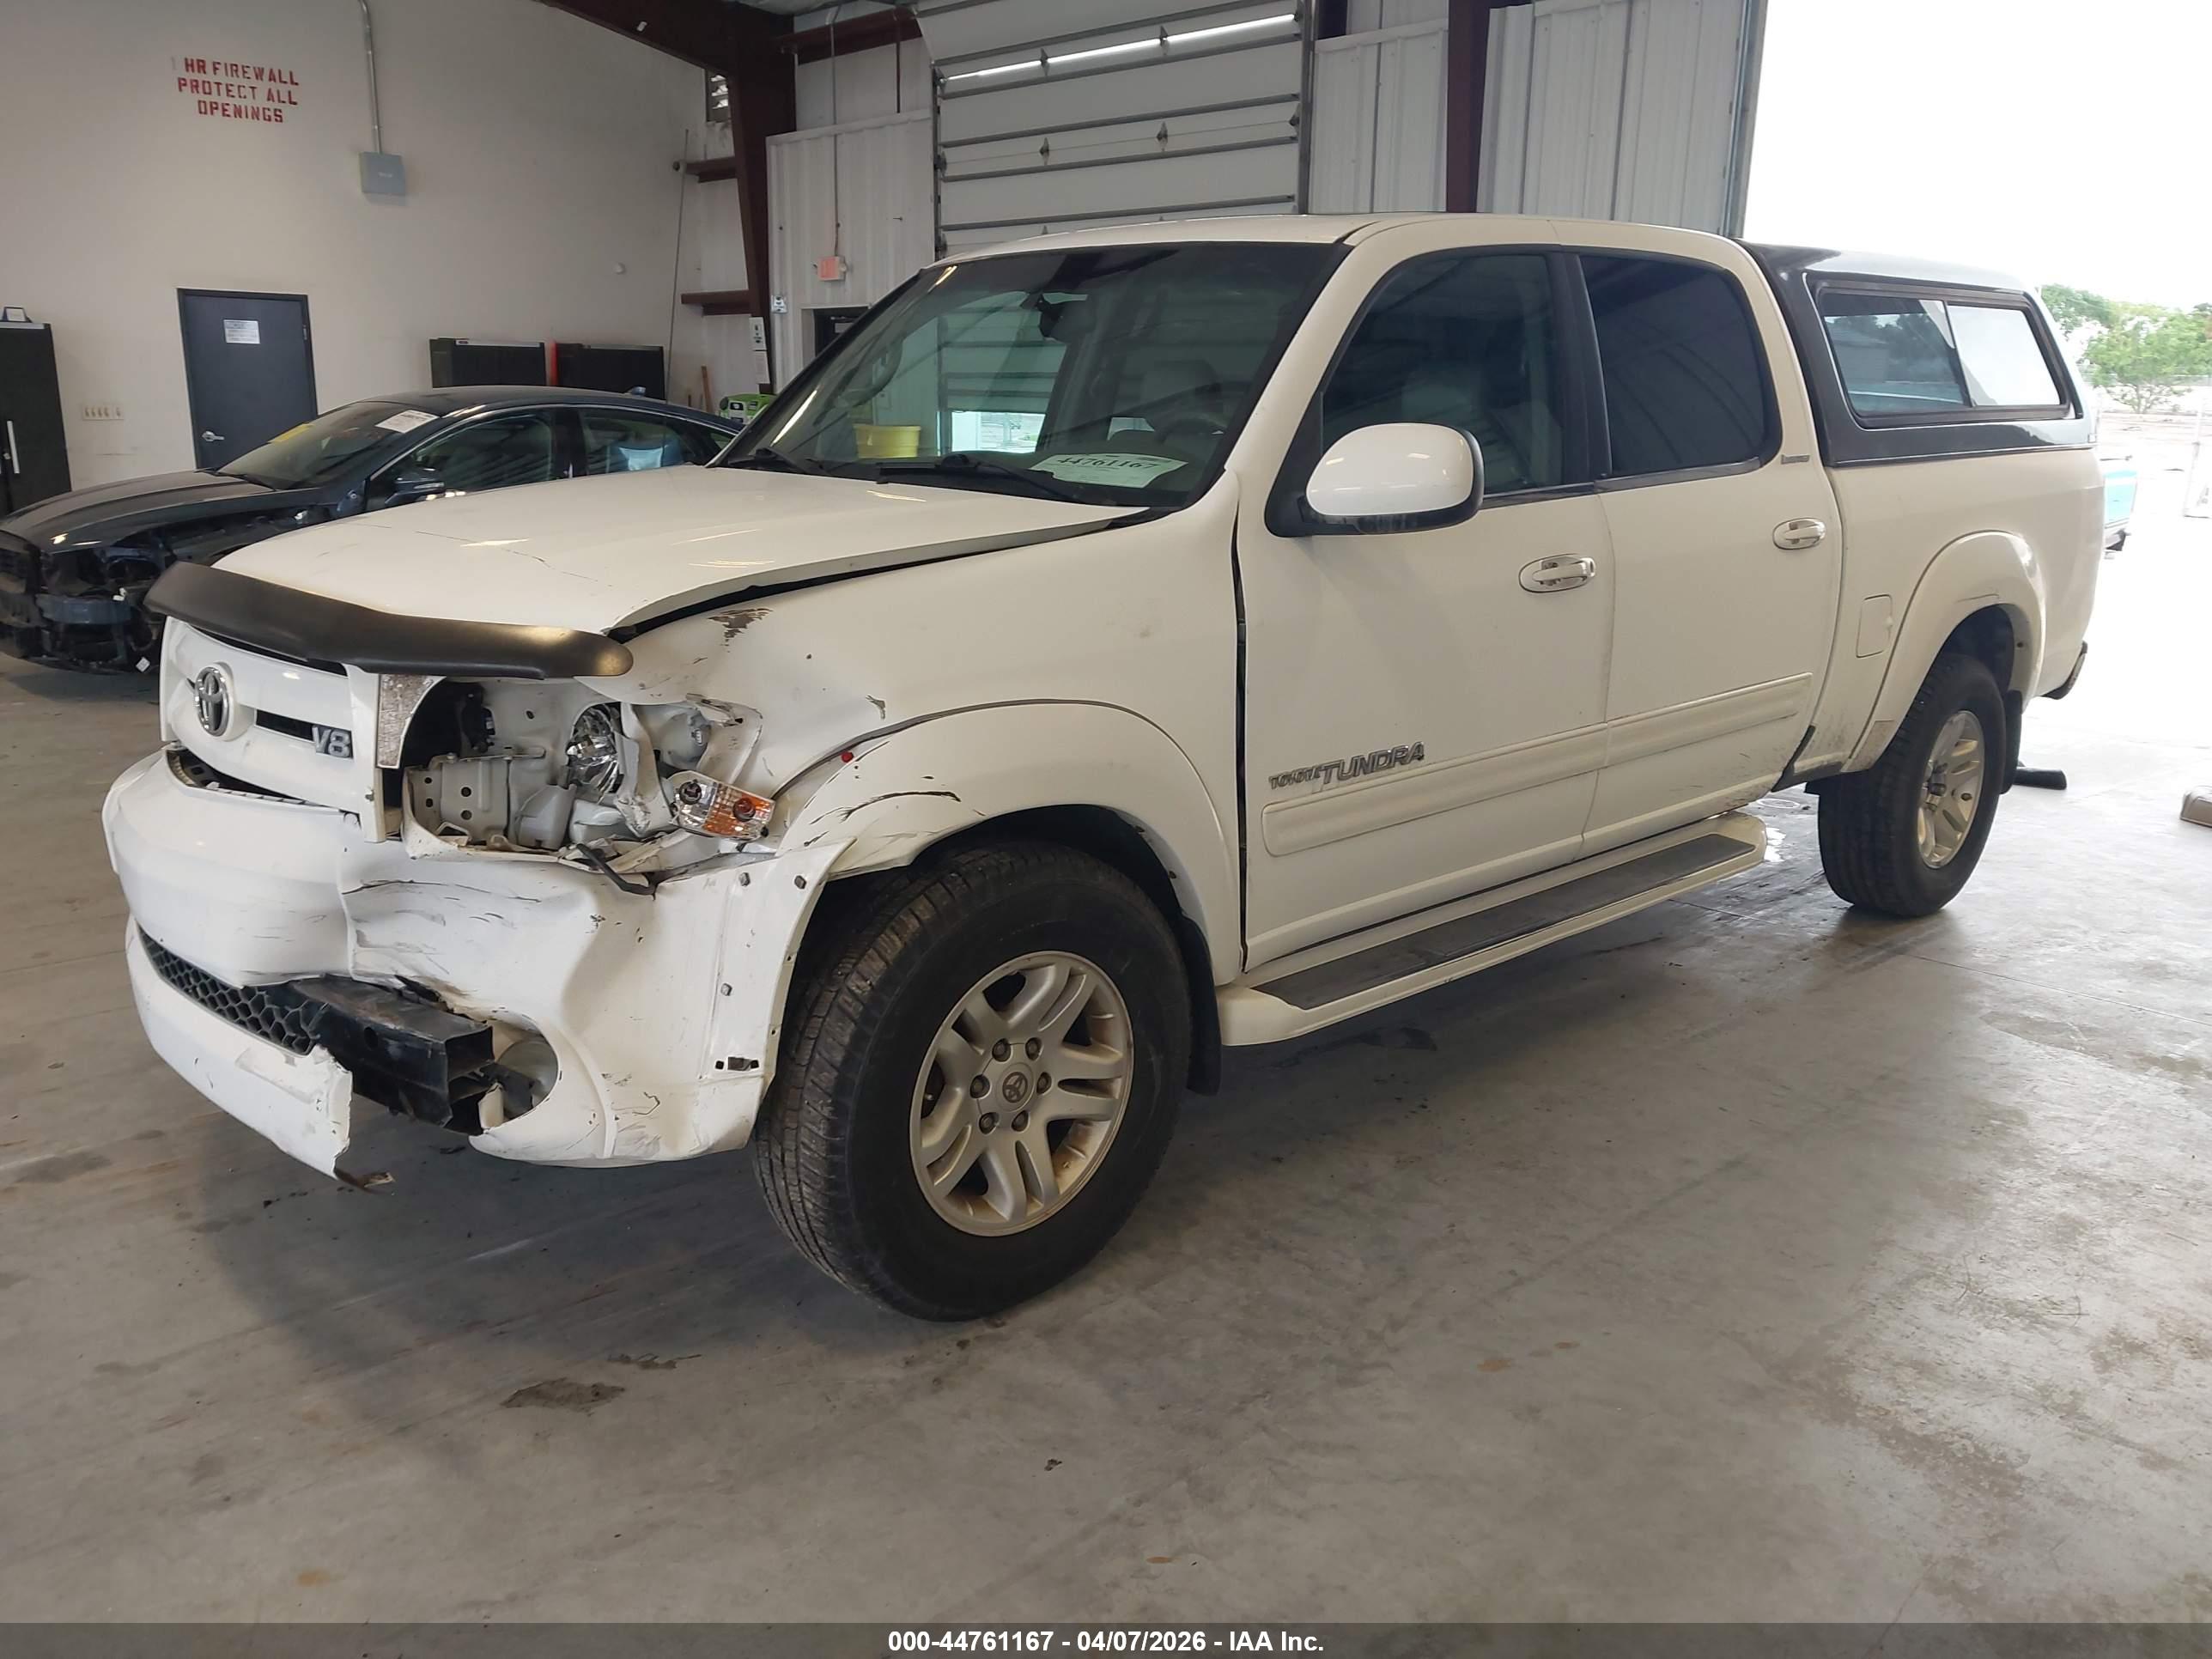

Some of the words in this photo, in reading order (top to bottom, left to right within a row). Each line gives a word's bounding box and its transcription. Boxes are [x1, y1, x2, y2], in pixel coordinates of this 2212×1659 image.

[184, 57, 207, 75] HR
[212, 61, 299, 86] FIREWALL
[177, 76, 257, 100] PROTECT
[266, 88, 298, 106] ALL
[198, 100, 283, 123] OPENINGS
[1056, 458, 1159, 469] 44761167
[313, 726, 350, 757] V8
[1318, 741, 1425, 784] TUNDRA
